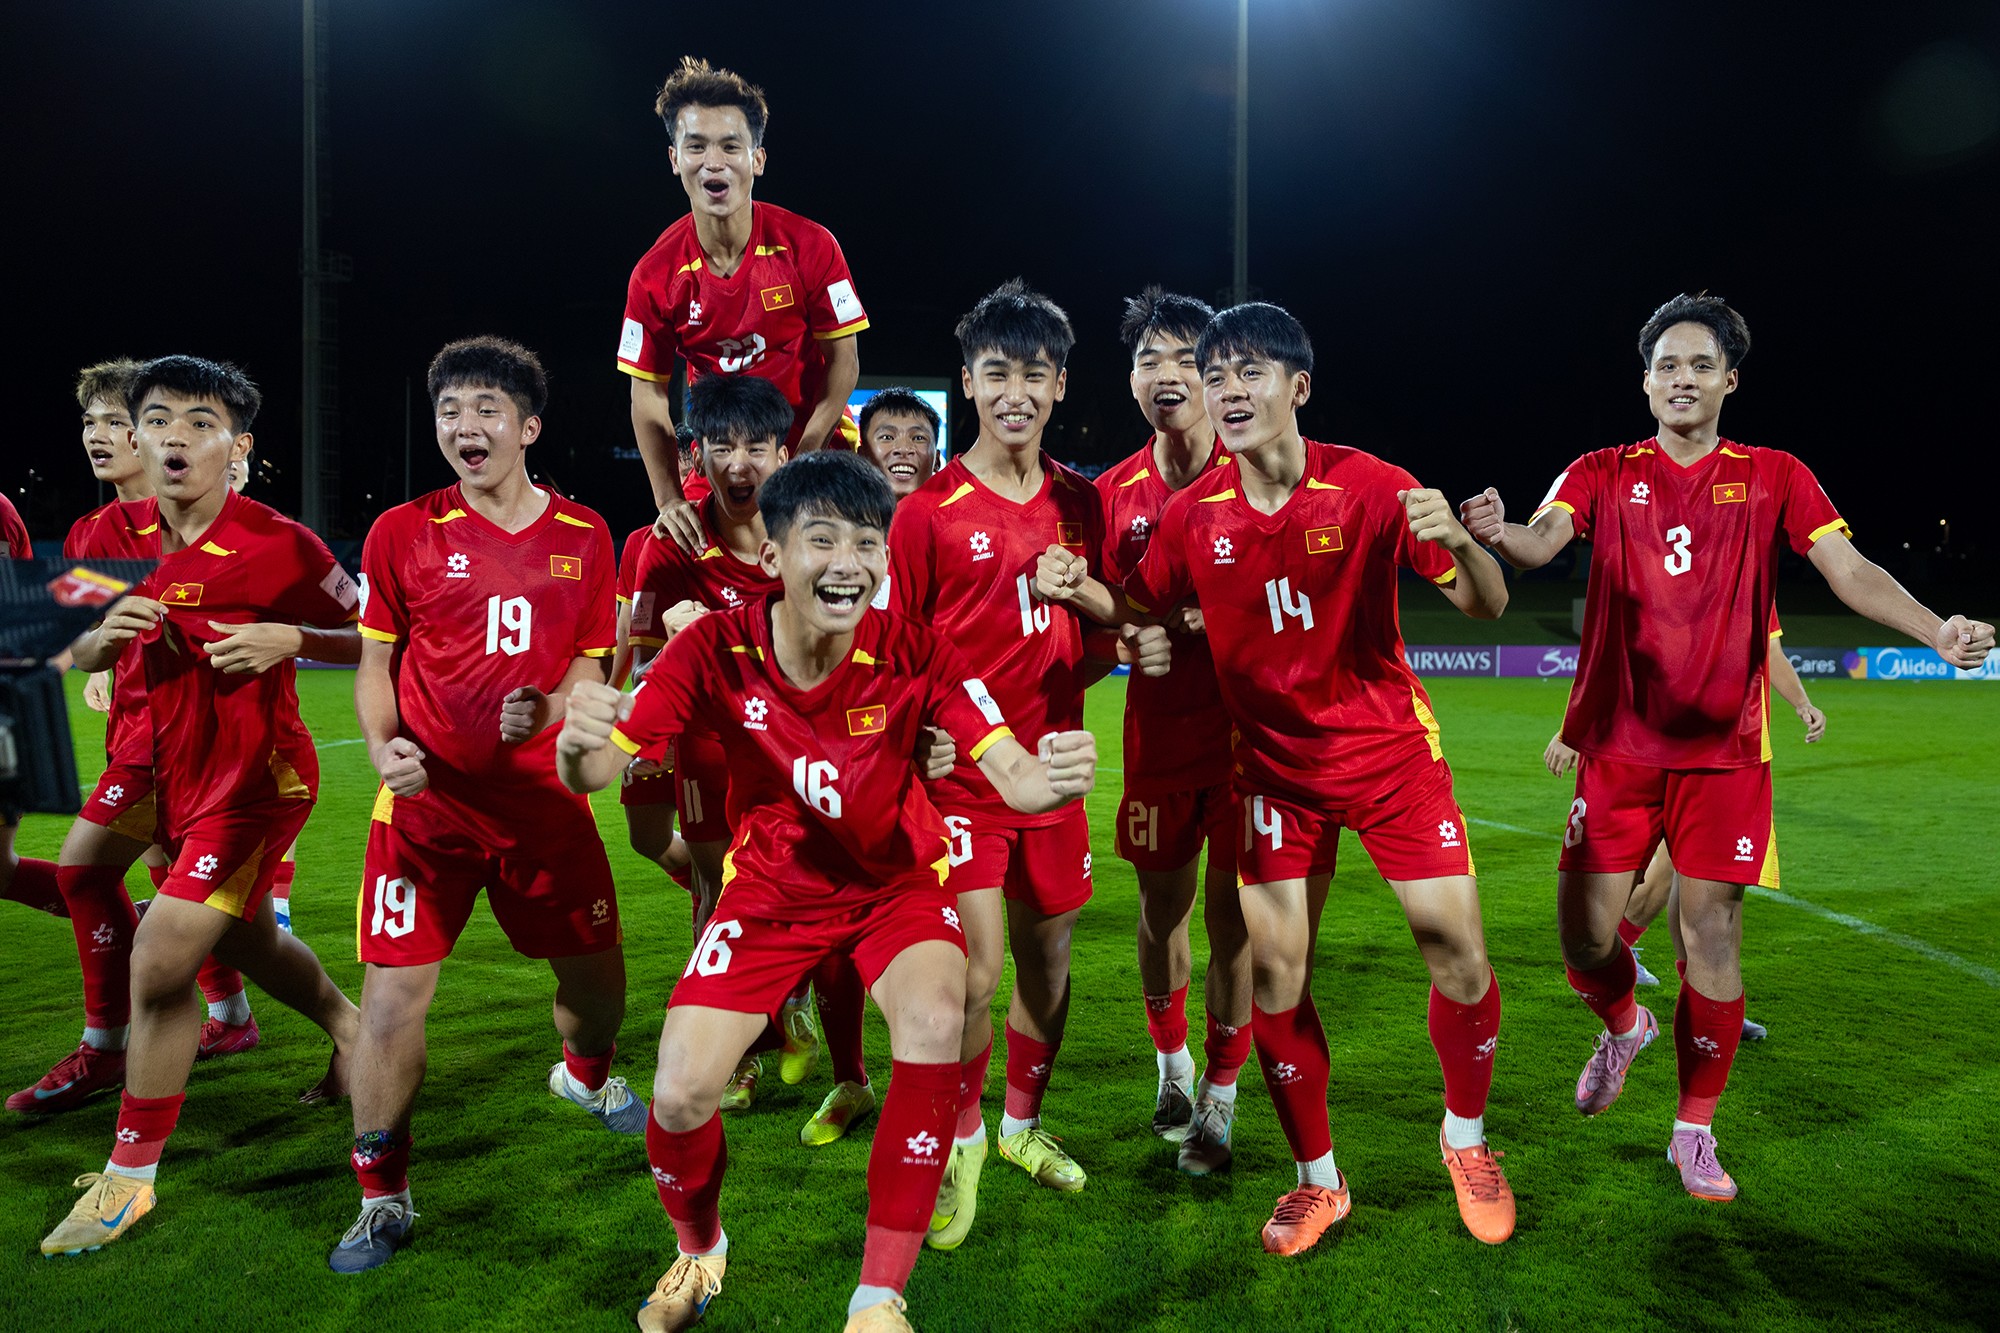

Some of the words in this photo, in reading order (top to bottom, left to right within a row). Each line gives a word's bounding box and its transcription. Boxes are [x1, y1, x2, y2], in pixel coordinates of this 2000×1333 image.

[1664, 524, 1692, 576] 3
[334, 576, 349, 598] AFC
[1265, 576, 1314, 634] 14
[485, 595, 532, 656] 19
[1404, 651, 1491, 671] AIRWAYS
[1788, 655, 1836, 673] Cares
[1881, 653, 1948, 678] Midea
[683, 778, 704, 824] 11
[793, 755, 842, 819] 16
[1128, 801, 1158, 851] 21
[1244, 795, 1282, 852] 14
[1564, 797, 1587, 849] 3
[370, 874, 416, 939] 19
[683, 919, 743, 979] 16
